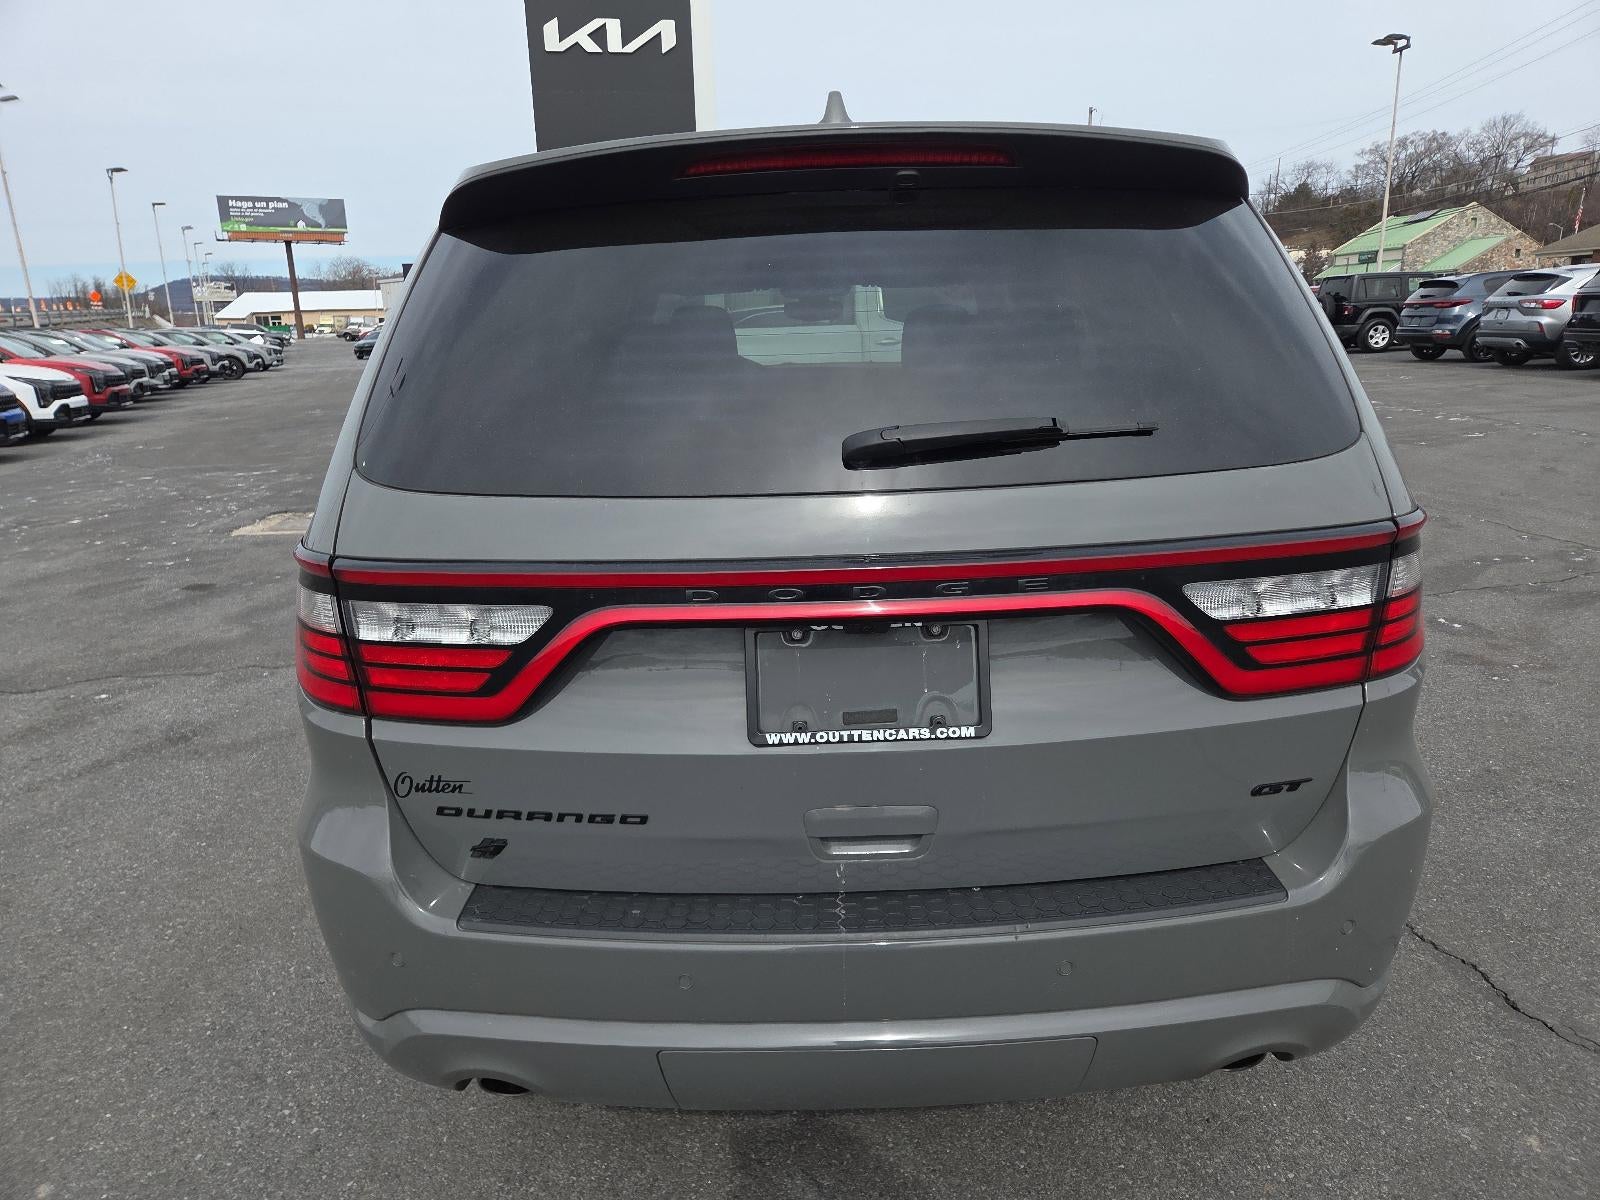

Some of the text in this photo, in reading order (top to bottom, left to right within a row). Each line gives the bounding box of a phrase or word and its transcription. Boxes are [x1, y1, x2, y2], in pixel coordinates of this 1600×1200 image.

[543, 16, 676, 54] KIA
[228, 199, 253, 209] Haga
[268, 200, 289, 209] plan
[686, 577, 1049, 601] DODGE
[765, 726, 976, 745] WWW.OUTTENCARS.COM
[394, 771, 473, 798] Outten
[1250, 777, 1313, 797] GT
[435, 806, 649, 826] DURANGO
